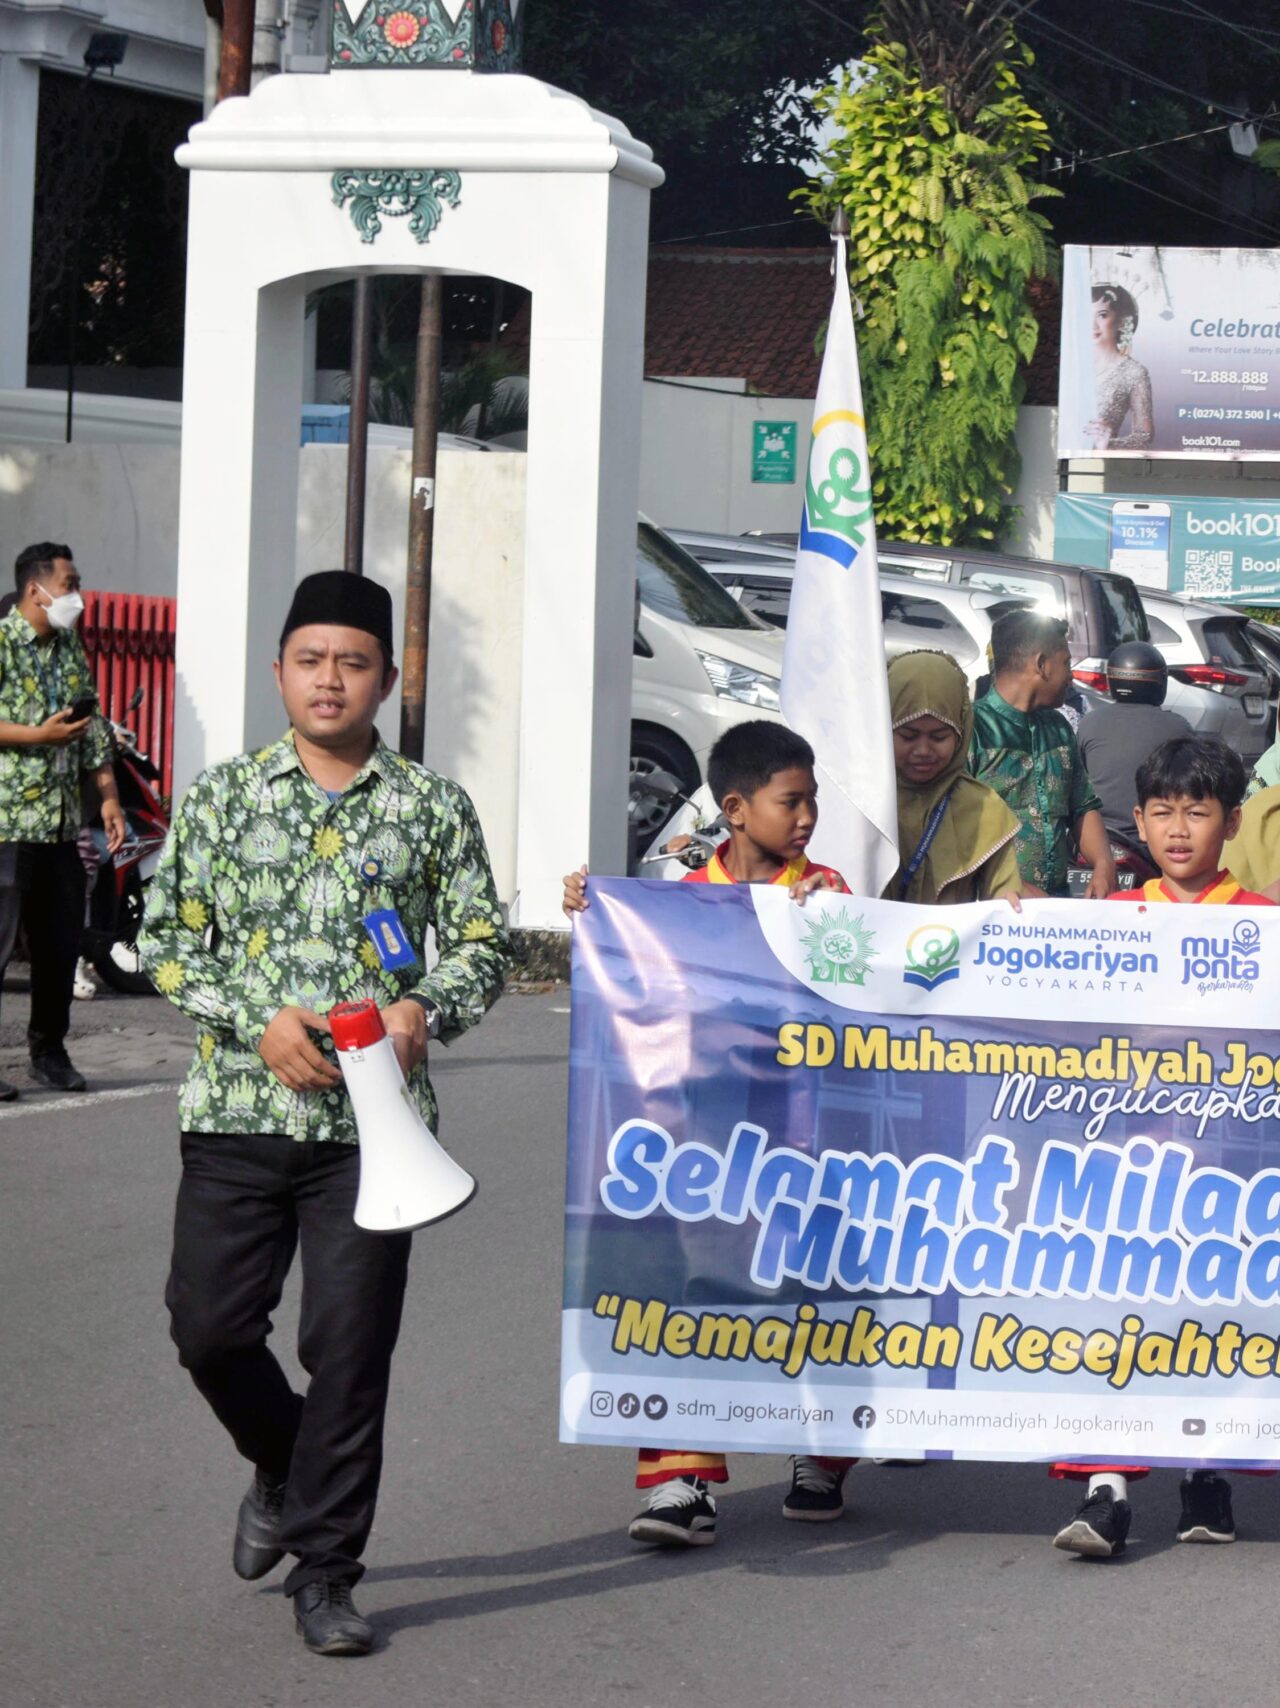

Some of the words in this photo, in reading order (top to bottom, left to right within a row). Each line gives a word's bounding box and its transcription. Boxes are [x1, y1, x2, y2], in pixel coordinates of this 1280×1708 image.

[1215, 346, 1232, 355] Your
[1253, 347, 1273, 356] Story
[1191, 370, 1269, 383] 12.888.888
[1178, 409, 1186, 418] P
[1193, 408, 1224, 419] (0274)
[1225, 410, 1242, 419] 372
[1245, 410, 1264, 419] 500
[1182, 436, 1241, 447] book101.com
[1121, 526, 1159, 539] 10.1%
[981, 924, 1003, 936] SD
[1007, 925, 1152, 943] MUHAMMADIYAH
[1181, 937, 1230, 958] mu
[973, 942, 1158, 976] Jogokariyan
[986, 974, 1144, 993] YOGYAKARTA
[776, 1022, 836, 1067] SD
[843, 1026, 1213, 1091] Muhammadiyah
[601, 1119, 1019, 1228] Selamat
[676, 1399, 834, 1425] sdm_jogokariyan
[886, 1409, 1047, 1432] SDMuhammadiyah
[1053, 1411, 1154, 1435] Jogokariyan
[1215, 1419, 1250, 1434] sdm
